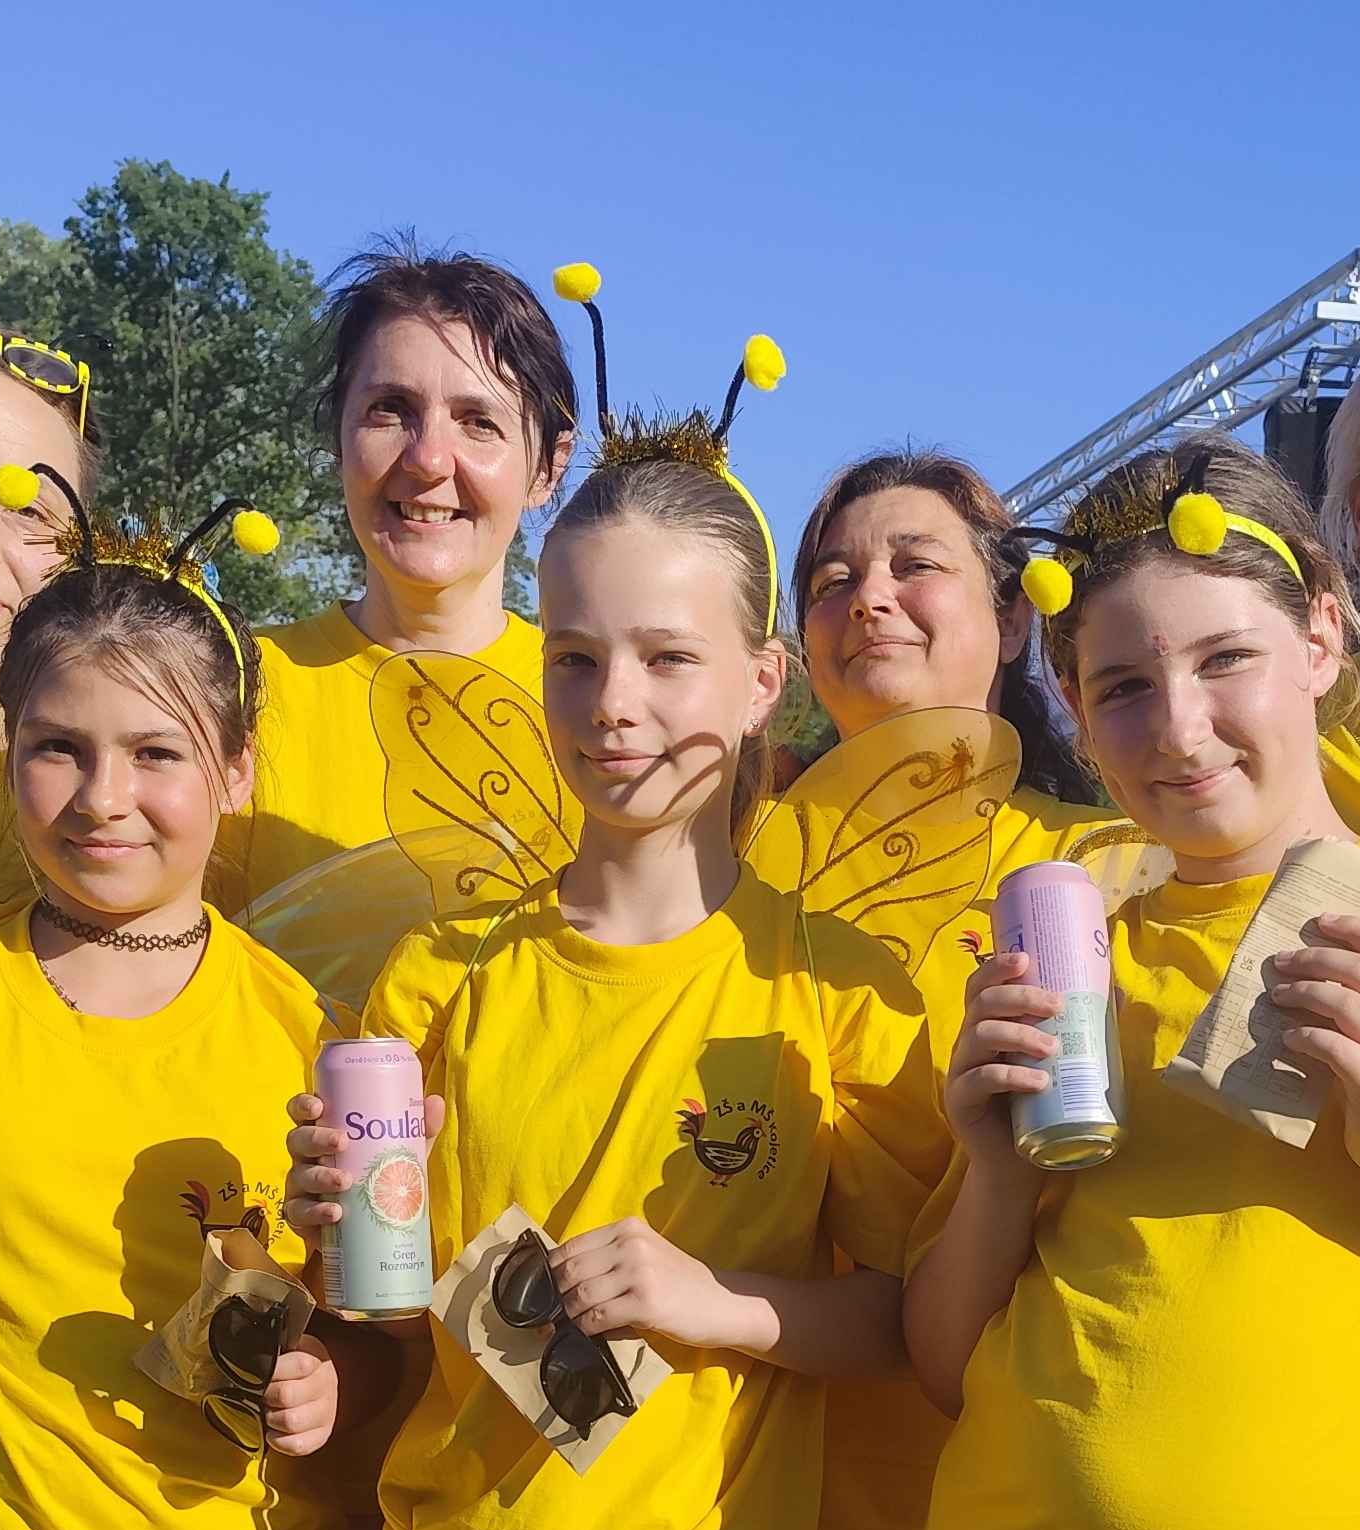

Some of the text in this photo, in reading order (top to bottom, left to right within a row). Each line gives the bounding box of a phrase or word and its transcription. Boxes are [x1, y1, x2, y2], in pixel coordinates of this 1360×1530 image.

[712, 1098, 733, 1118] ZŠ
[737, 1102, 746, 1112] a
[751, 1100, 775, 1122] MŠ
[217, 1182, 238, 1202] ZŠ
[242, 1184, 250, 1192] a
[255, 1182, 279, 1200] MŠ
[392, 1250, 417, 1262] Grep
